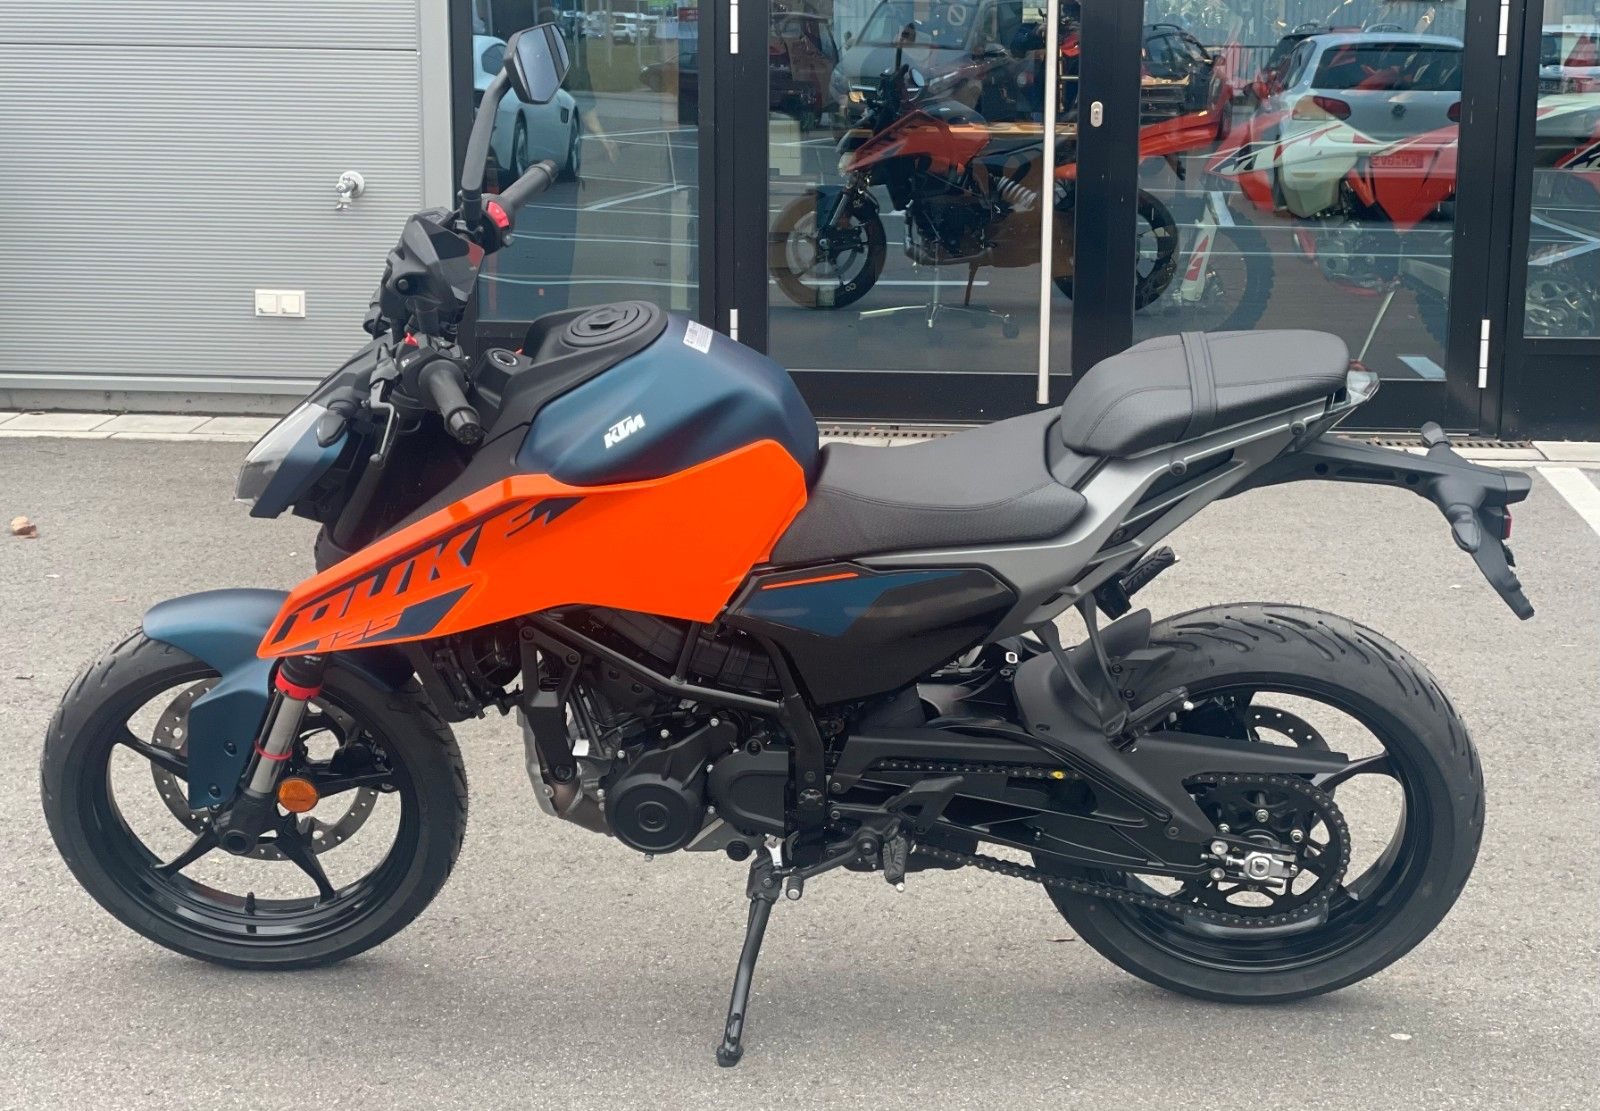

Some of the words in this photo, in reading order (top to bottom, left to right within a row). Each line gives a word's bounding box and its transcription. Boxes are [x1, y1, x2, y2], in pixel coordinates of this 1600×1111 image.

[604, 413, 645, 449] KTM
[275, 497, 562, 645] DUKE
[316, 612, 402, 650] 125
